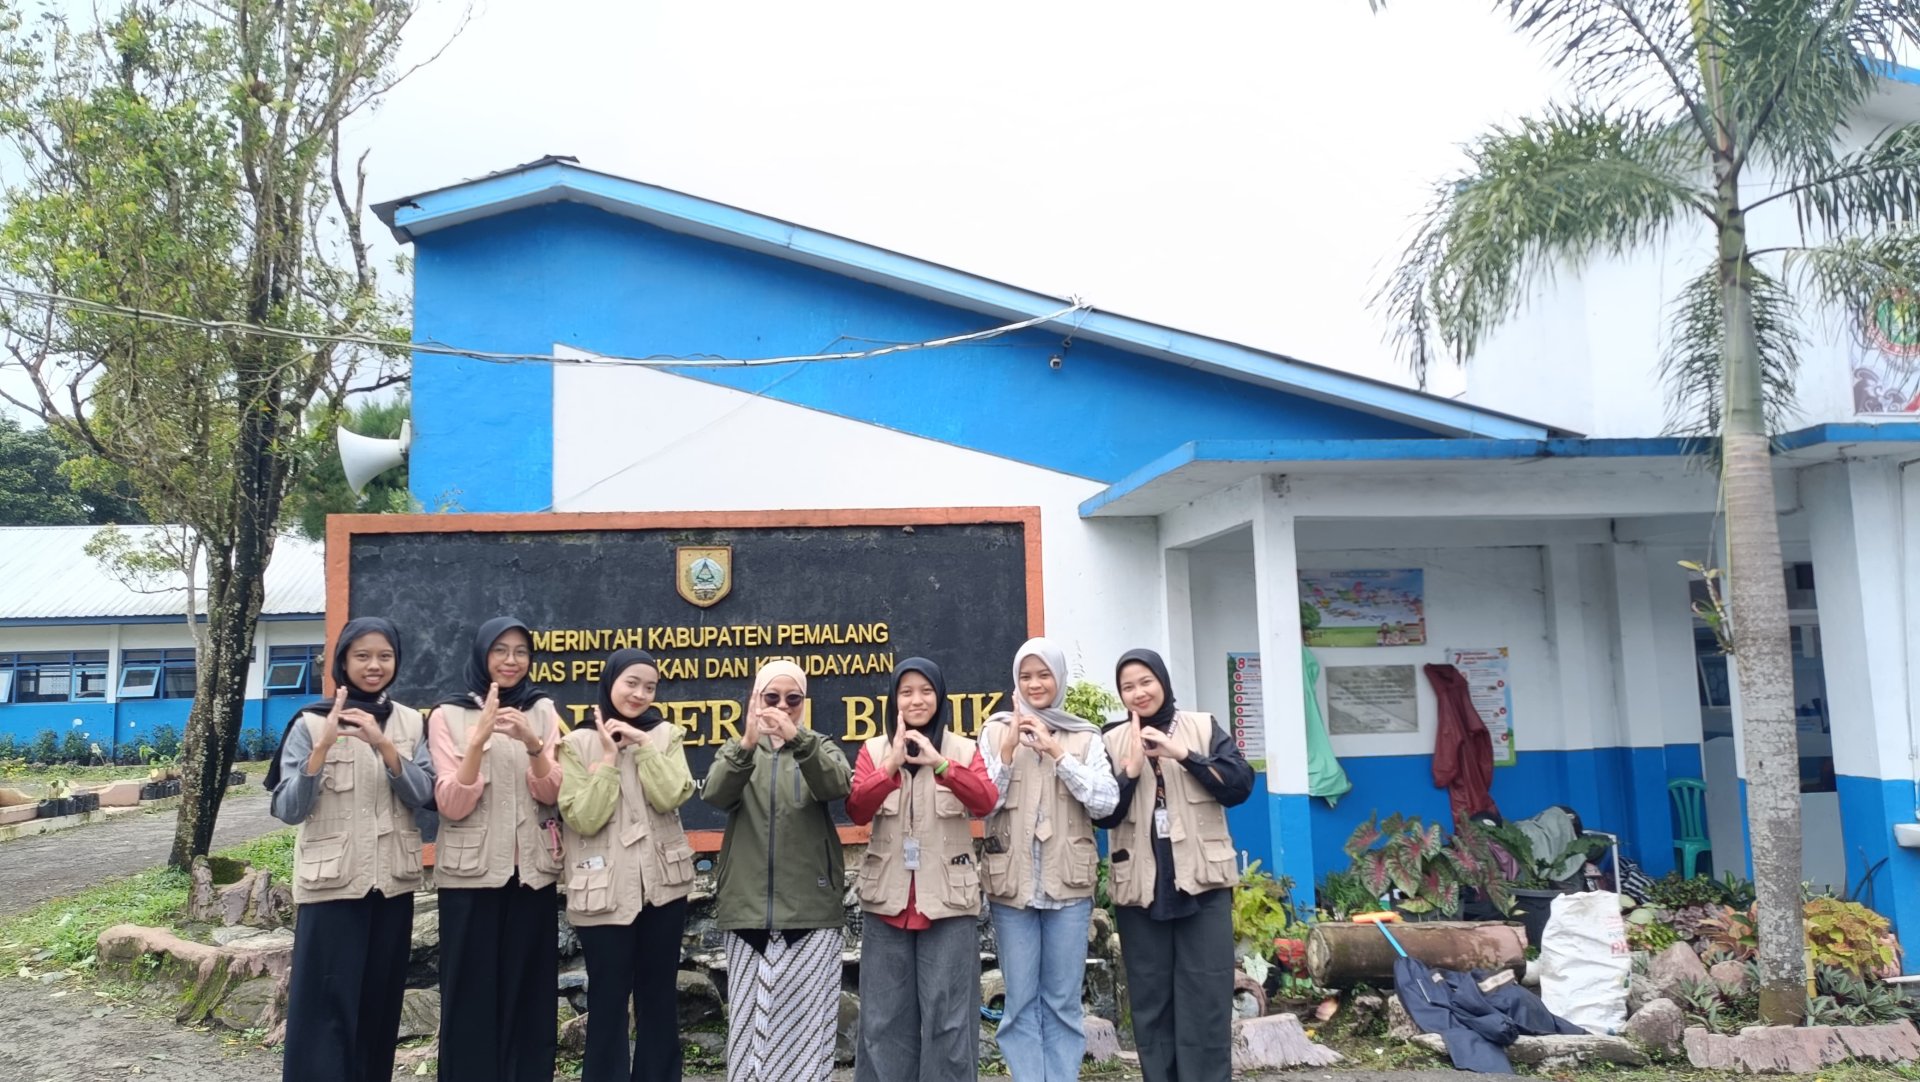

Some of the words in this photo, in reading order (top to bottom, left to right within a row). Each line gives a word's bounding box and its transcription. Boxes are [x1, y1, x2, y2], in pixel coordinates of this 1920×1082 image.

[529, 630, 642, 652] MERINTAH
[649, 627, 772, 649] KABUPATEN
[778, 623, 889, 645] PEMALANG
[530, 661, 566, 682] NAS
[705, 657, 749, 679] DAN
[841, 693, 1003, 741] BIK
